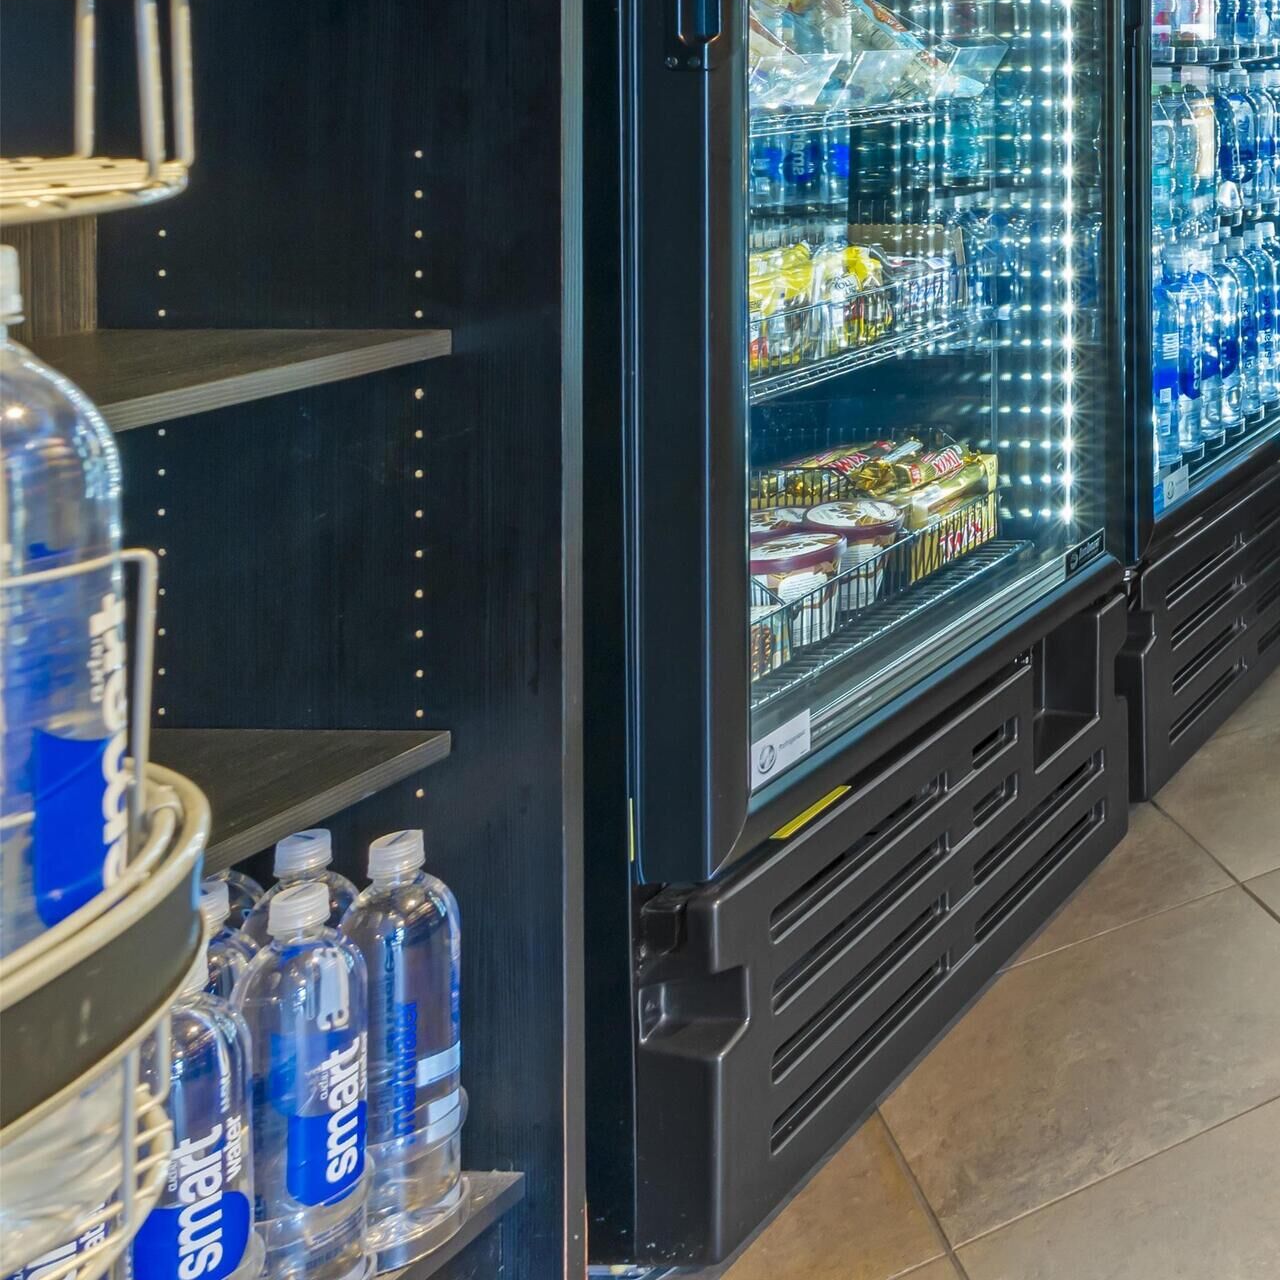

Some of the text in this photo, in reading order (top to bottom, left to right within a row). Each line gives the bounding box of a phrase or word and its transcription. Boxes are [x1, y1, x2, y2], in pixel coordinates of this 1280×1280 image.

[327, 1038, 361, 1185] smart
[178, 1115, 244, 1280] smart water
